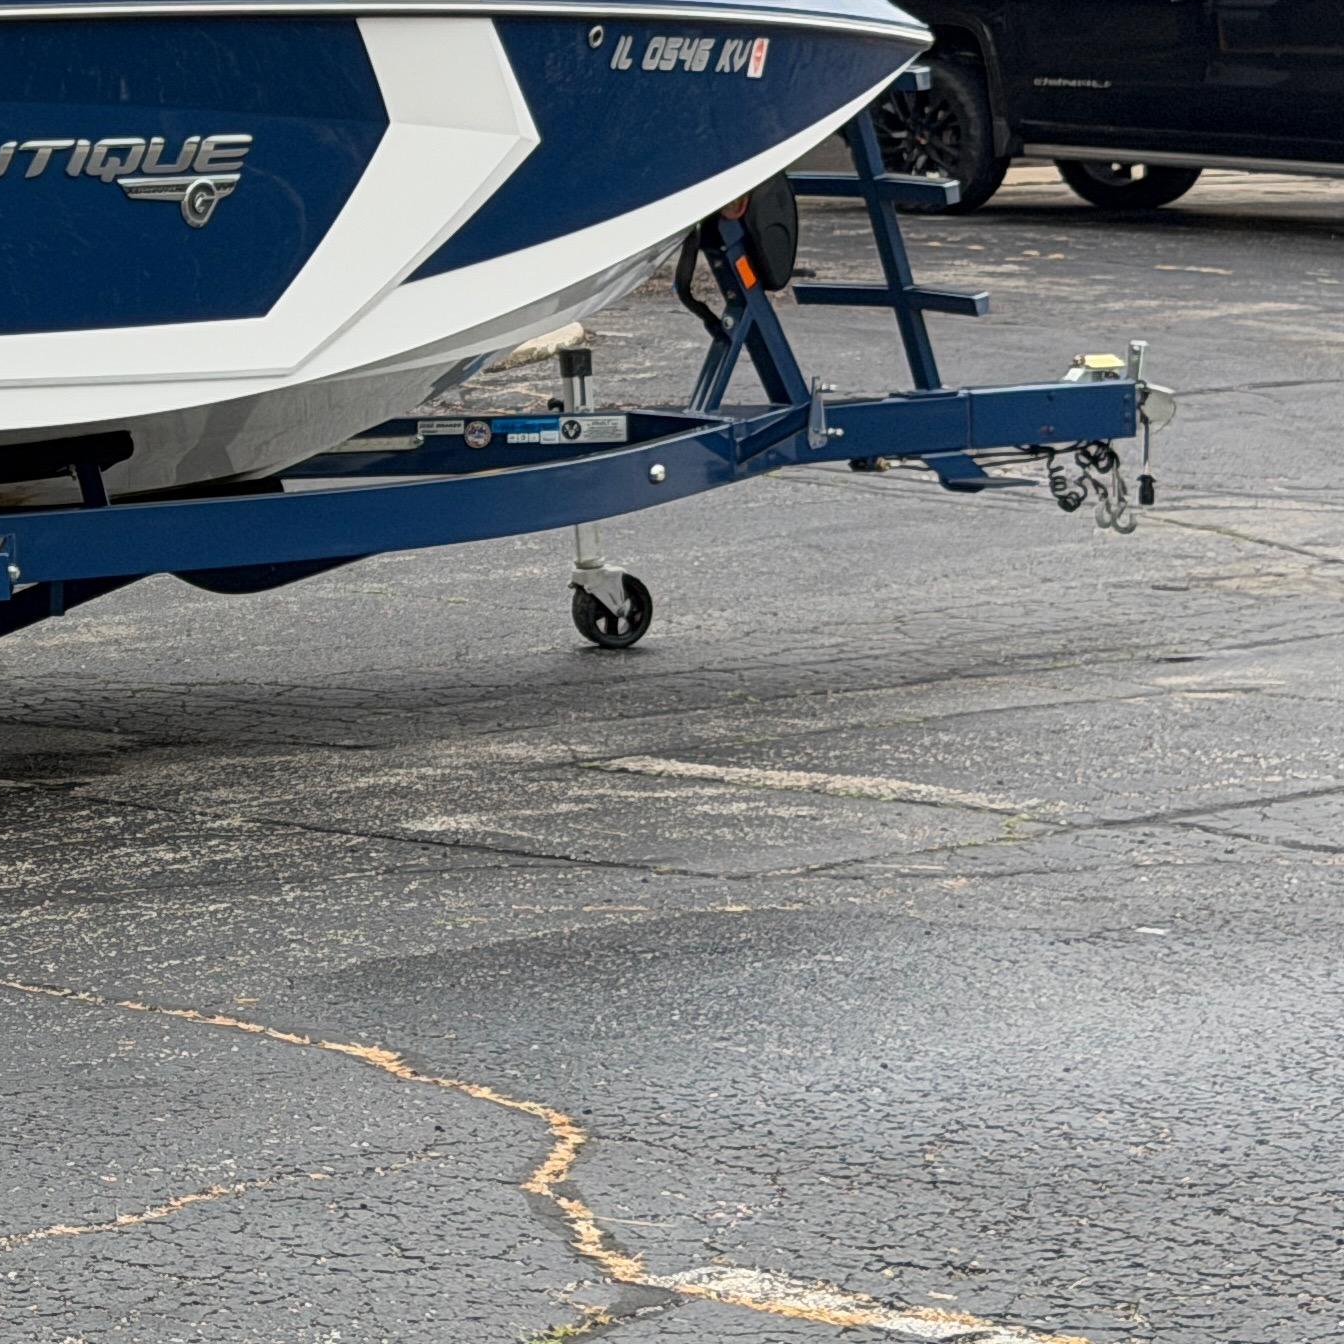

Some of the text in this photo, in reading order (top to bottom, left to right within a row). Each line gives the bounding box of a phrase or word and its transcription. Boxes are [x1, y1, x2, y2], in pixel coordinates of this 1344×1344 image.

[610, 35, 753, 74] IL 0546 KV
